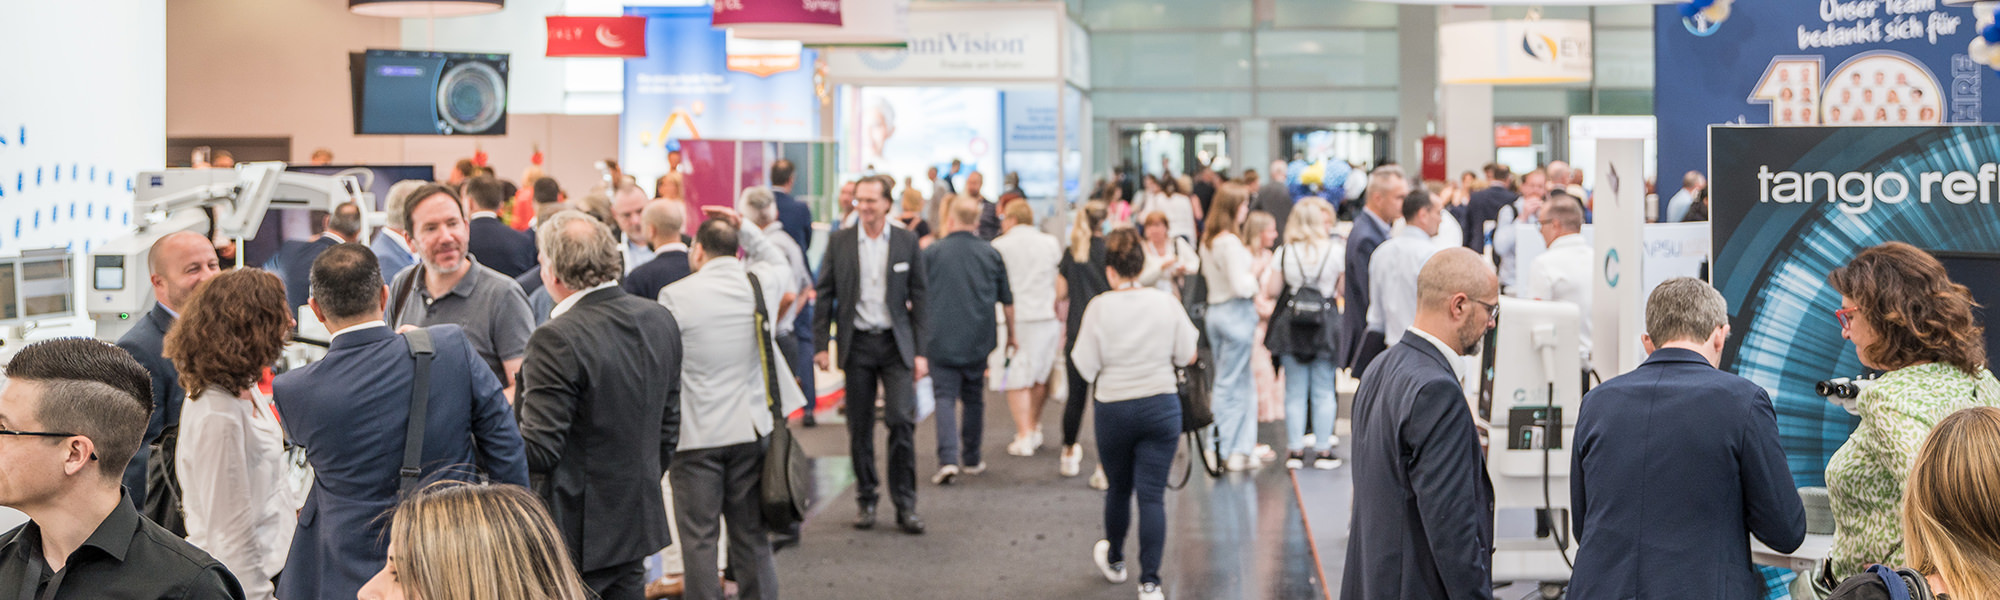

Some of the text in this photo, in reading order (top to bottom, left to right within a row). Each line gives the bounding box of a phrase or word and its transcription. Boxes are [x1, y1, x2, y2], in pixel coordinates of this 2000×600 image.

[1797, 11, 1961, 50] bedankt sich für
[1819, 0, 1879, 22] Unser
[1757, 162, 2000, 214] tango ref
